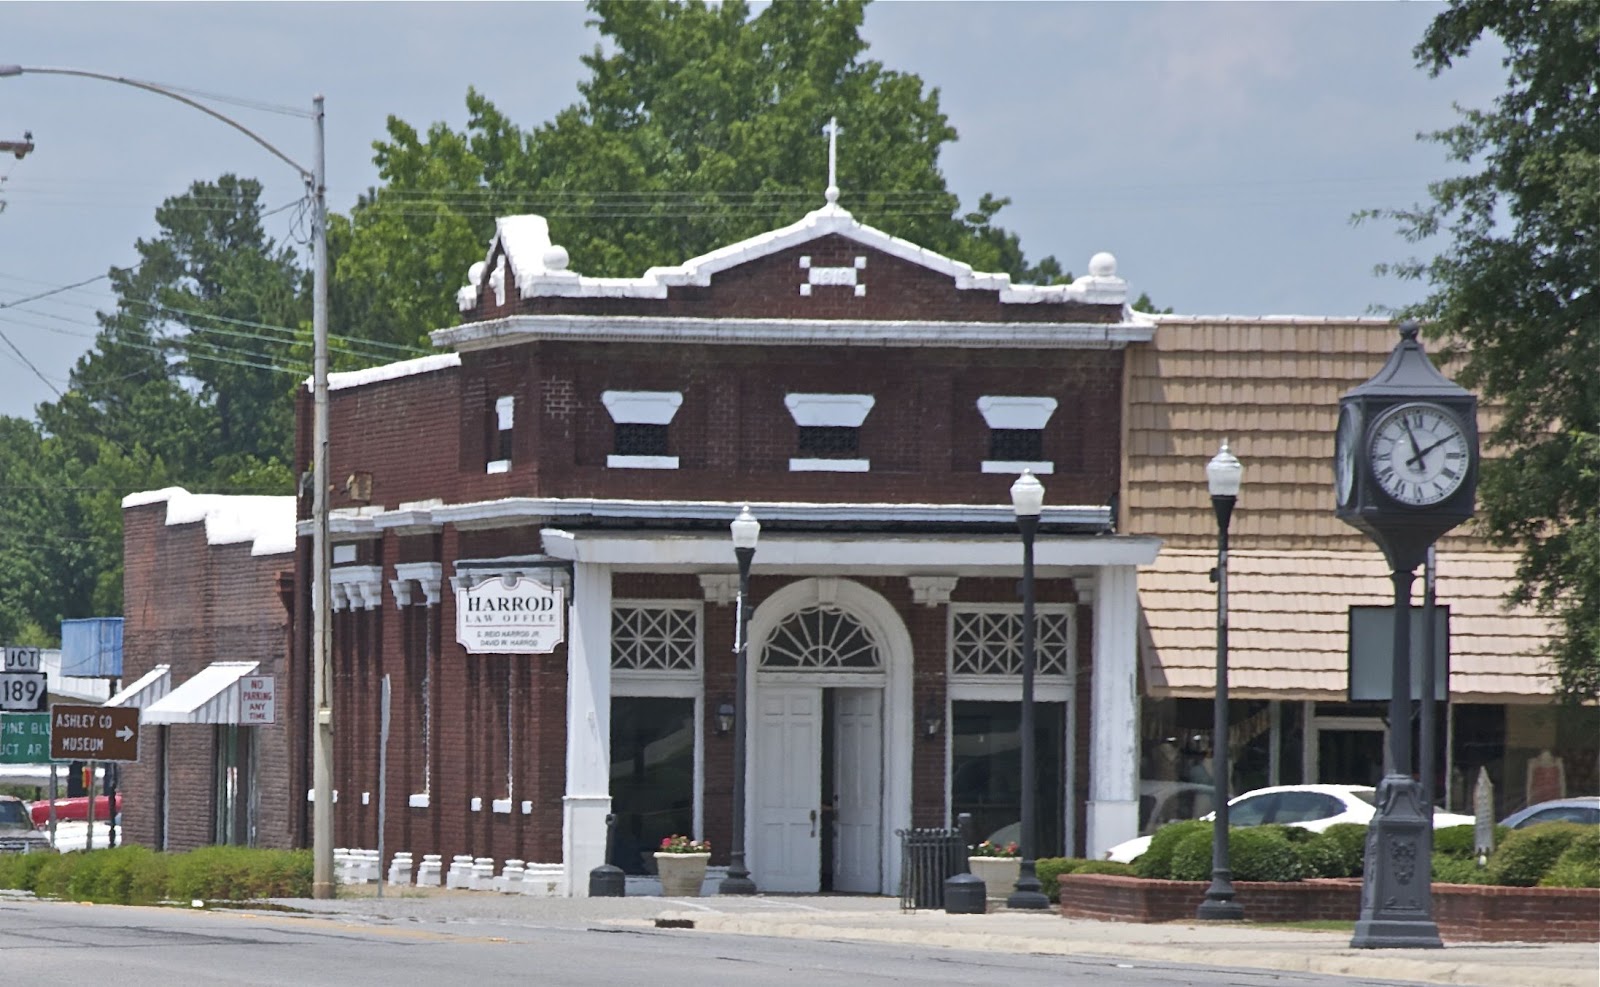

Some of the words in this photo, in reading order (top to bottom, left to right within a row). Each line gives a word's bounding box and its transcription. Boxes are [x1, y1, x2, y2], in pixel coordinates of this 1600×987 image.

[468, 596, 554, 612] HARROD
[465, 614, 493, 623] LAW
[502, 613, 556, 623] OFFICE
[480, 639, 500, 647] DAVID
[7, 650, 37, 667] JCT
[3, 680, 38, 702] 189
[251, 680, 264, 690] NO
[243, 691, 272, 701] PARKING
[249, 703, 266, 711] ANY
[55, 713, 96, 728] ASHLEY
[98, 714, 113, 729] CO
[249, 712, 266, 720] TIME
[1, 722, 25, 735] PINE
[27, 743, 42, 756] AR
[62, 737, 104, 752] MUSEUM
